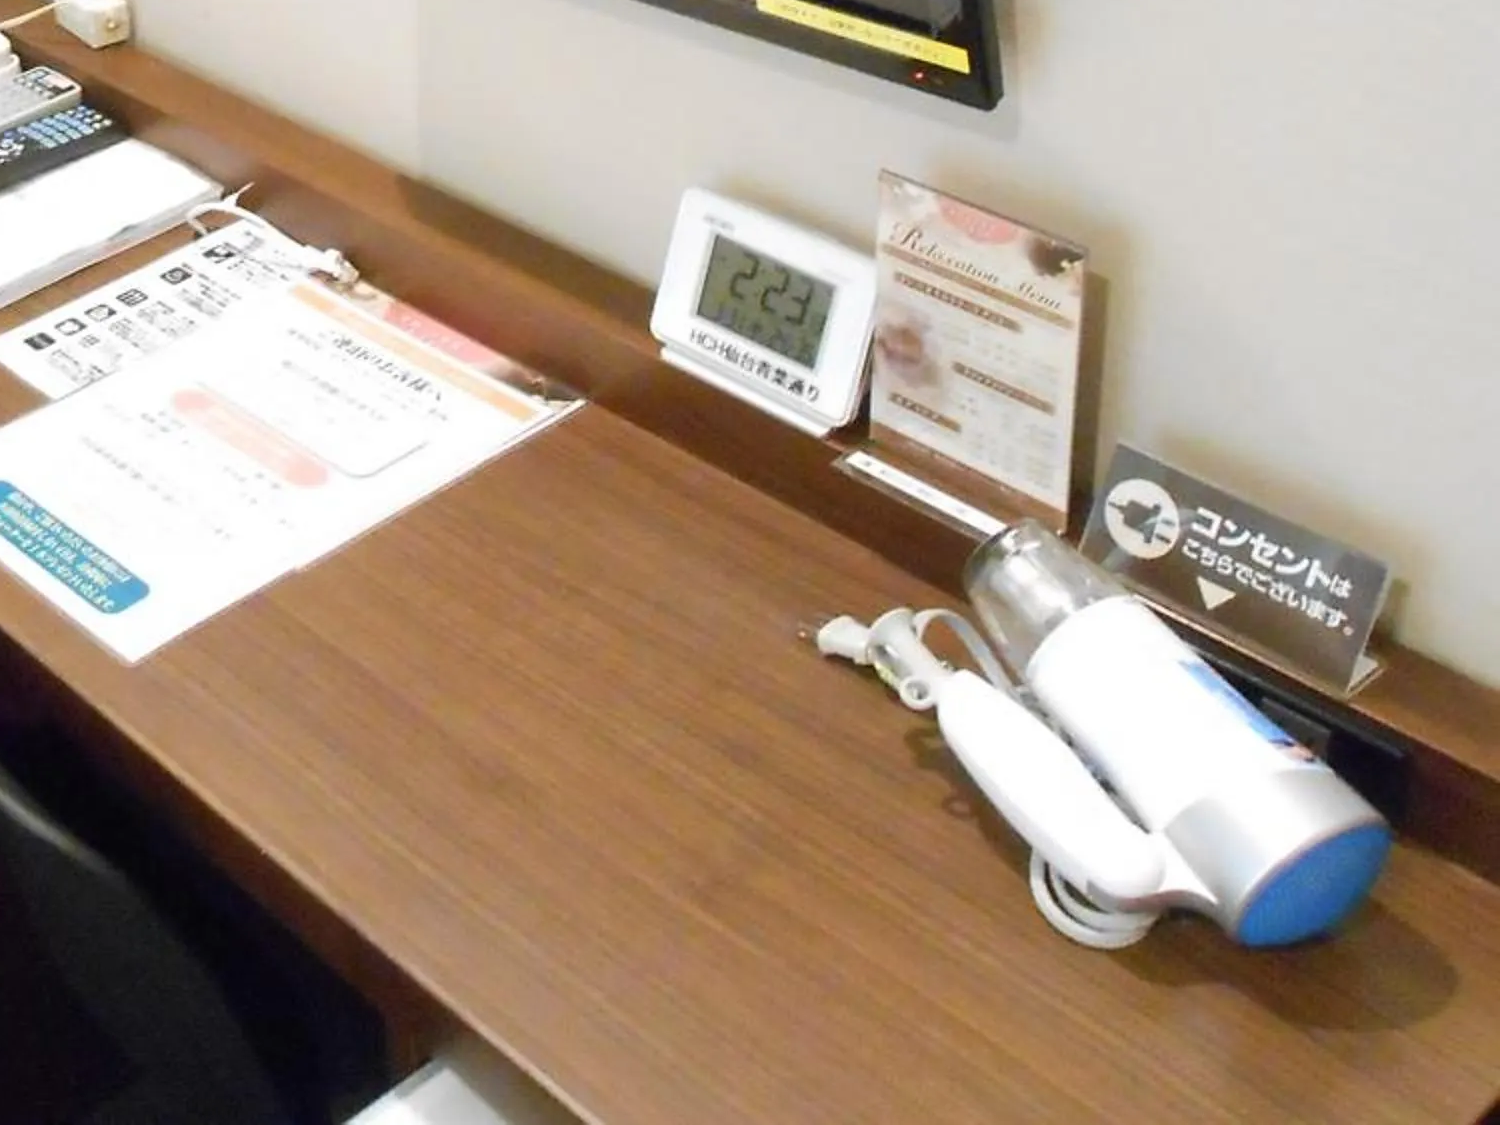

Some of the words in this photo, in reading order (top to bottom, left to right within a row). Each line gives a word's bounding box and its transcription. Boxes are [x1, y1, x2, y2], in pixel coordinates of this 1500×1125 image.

[1181, 537, 1354, 636] こちらでございます。
[1191, 506, 1353, 599] コンセントは
